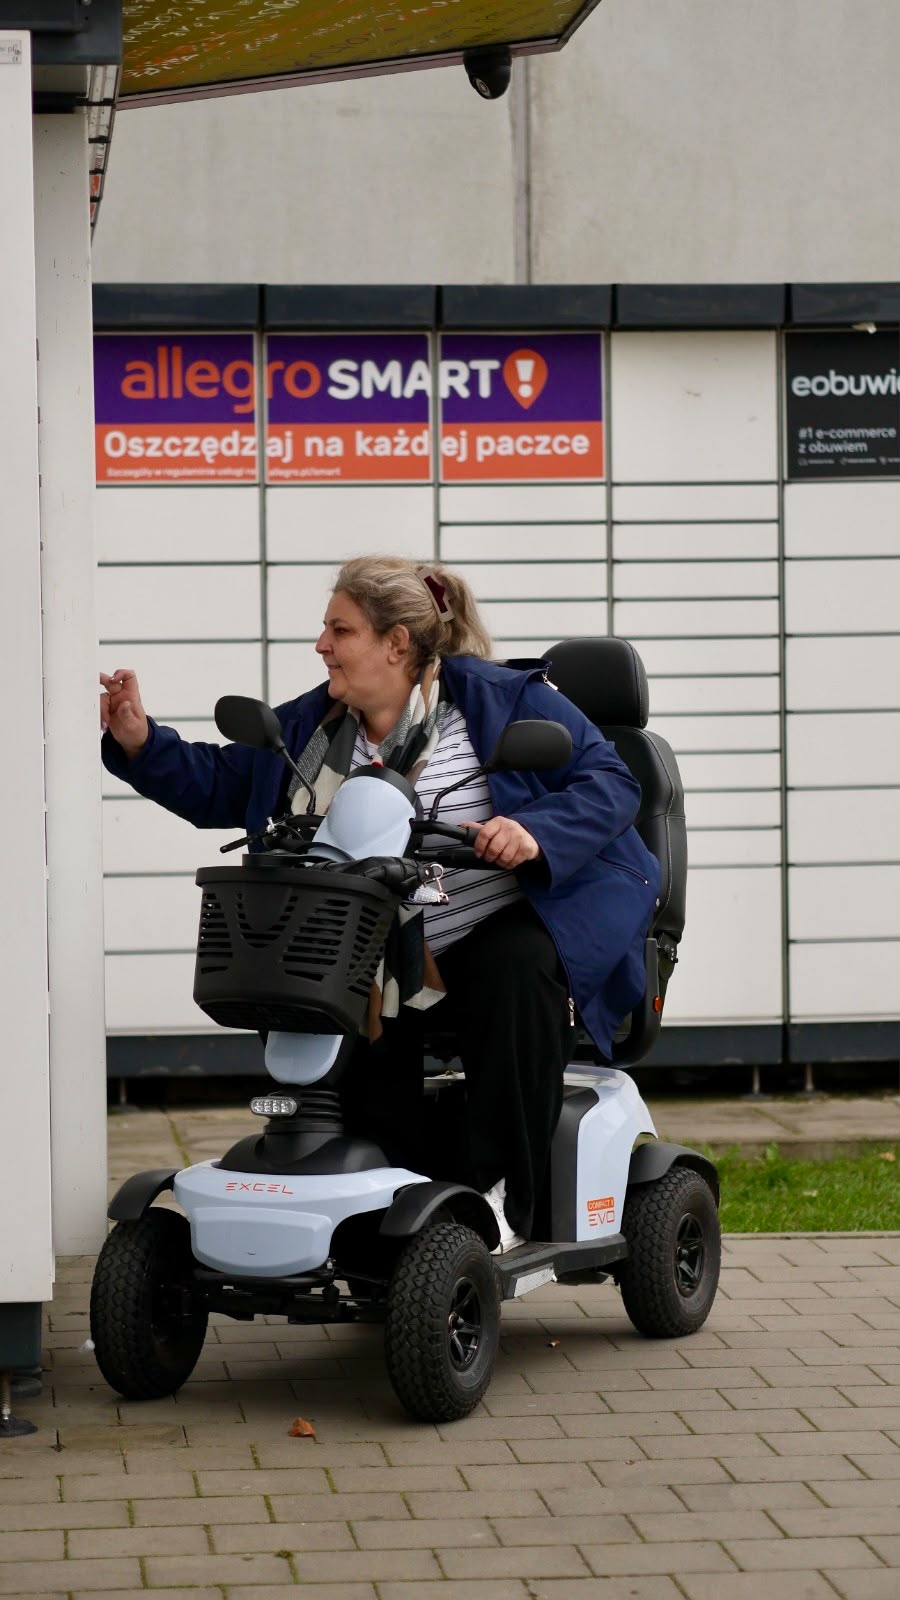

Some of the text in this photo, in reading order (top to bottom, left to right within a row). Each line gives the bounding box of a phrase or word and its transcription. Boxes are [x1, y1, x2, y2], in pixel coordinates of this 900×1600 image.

[120, 346, 322, 414] allegro
[791, 368, 900, 397] eobuwi
[815, 427, 897, 439] e-commerce
[104, 428, 590, 463] Oszczędzaj na każdej paczce
[798, 440, 868, 454] z obuwiem
[225, 1182, 294, 1195] EXCEL
[588, 1210, 615, 1227] EVO
